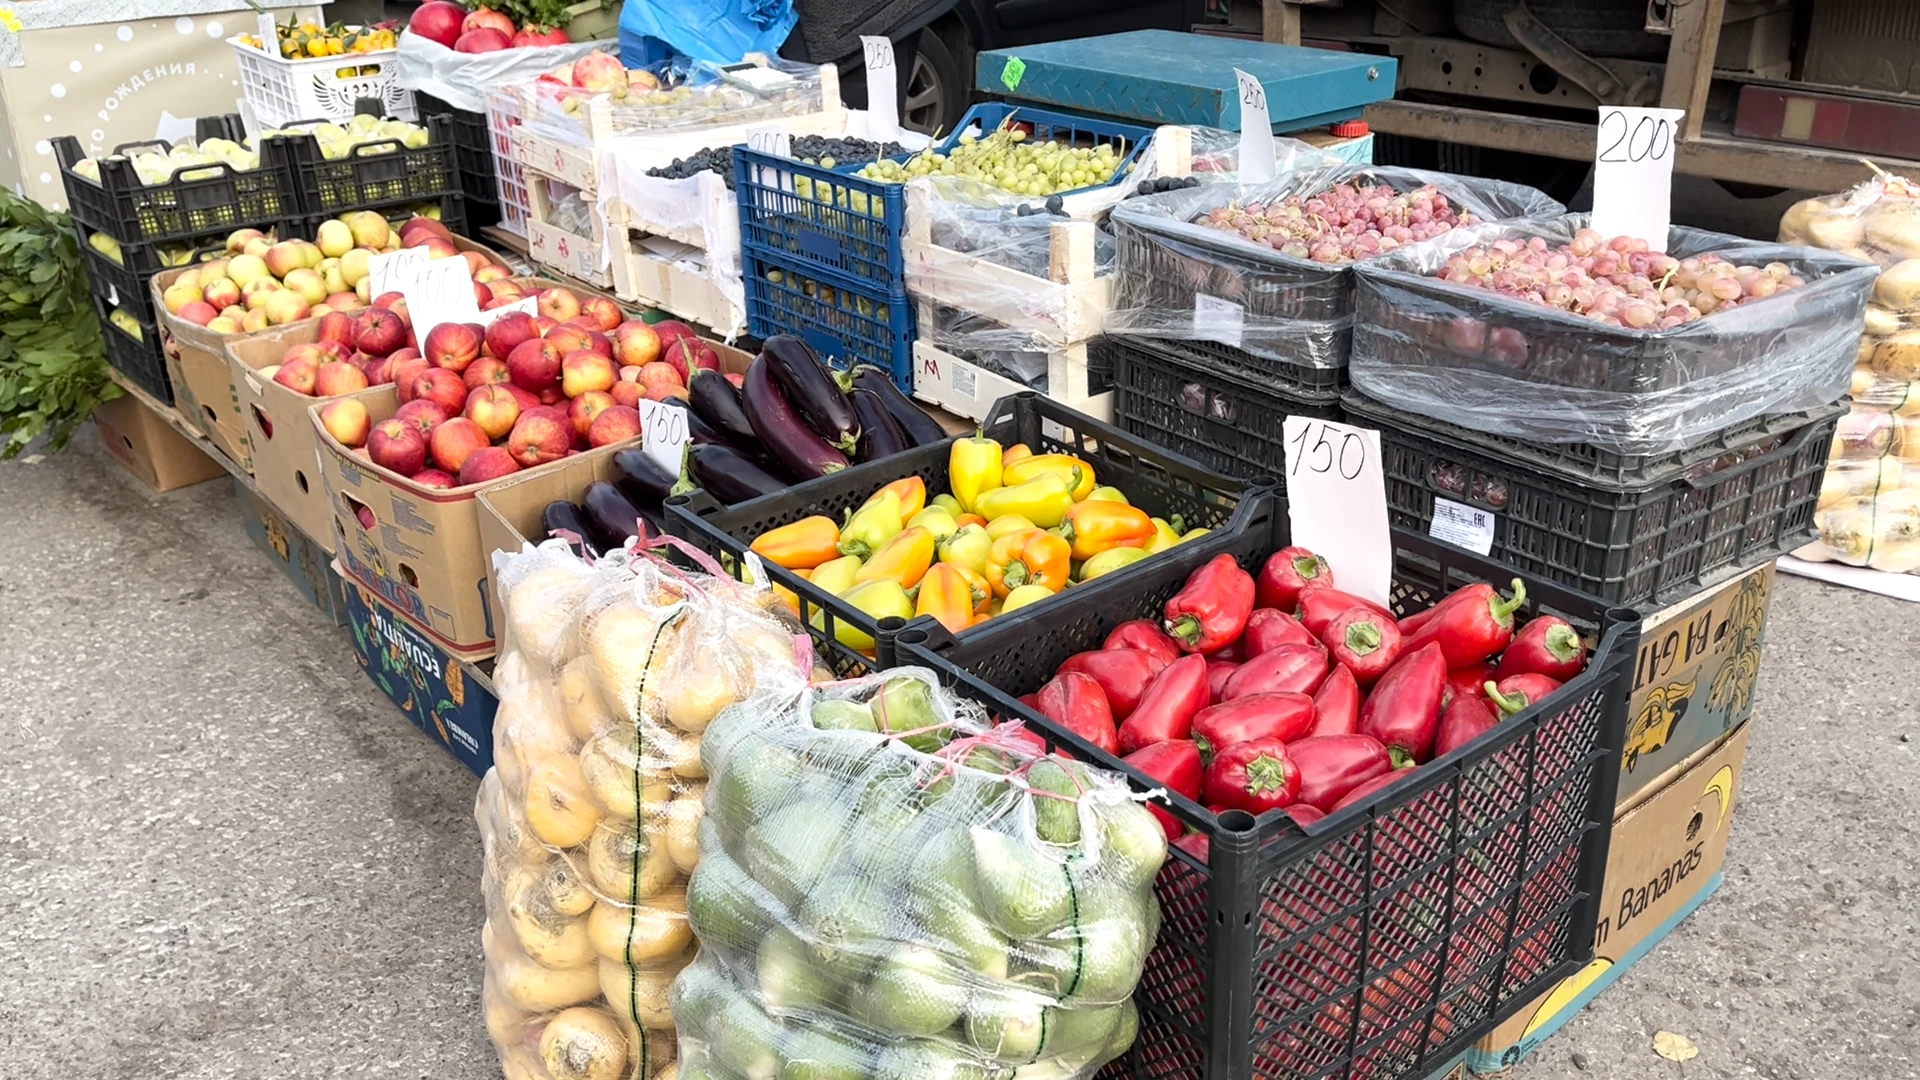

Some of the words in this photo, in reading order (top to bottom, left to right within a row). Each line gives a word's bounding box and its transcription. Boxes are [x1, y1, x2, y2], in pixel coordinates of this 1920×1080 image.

[866, 42, 892, 70] 250
[90, 129, 105, 160] ТО
[98, 63, 196, 121] РОЖДЕНИЯ
[1599, 110, 1670, 162] 200
[376, 253, 425, 293] 10
[411, 266, 462, 315] 100
[645, 405, 683, 446] 150
[1292, 422, 1365, 480] 150
[1617, 840, 1705, 931] Bananas
